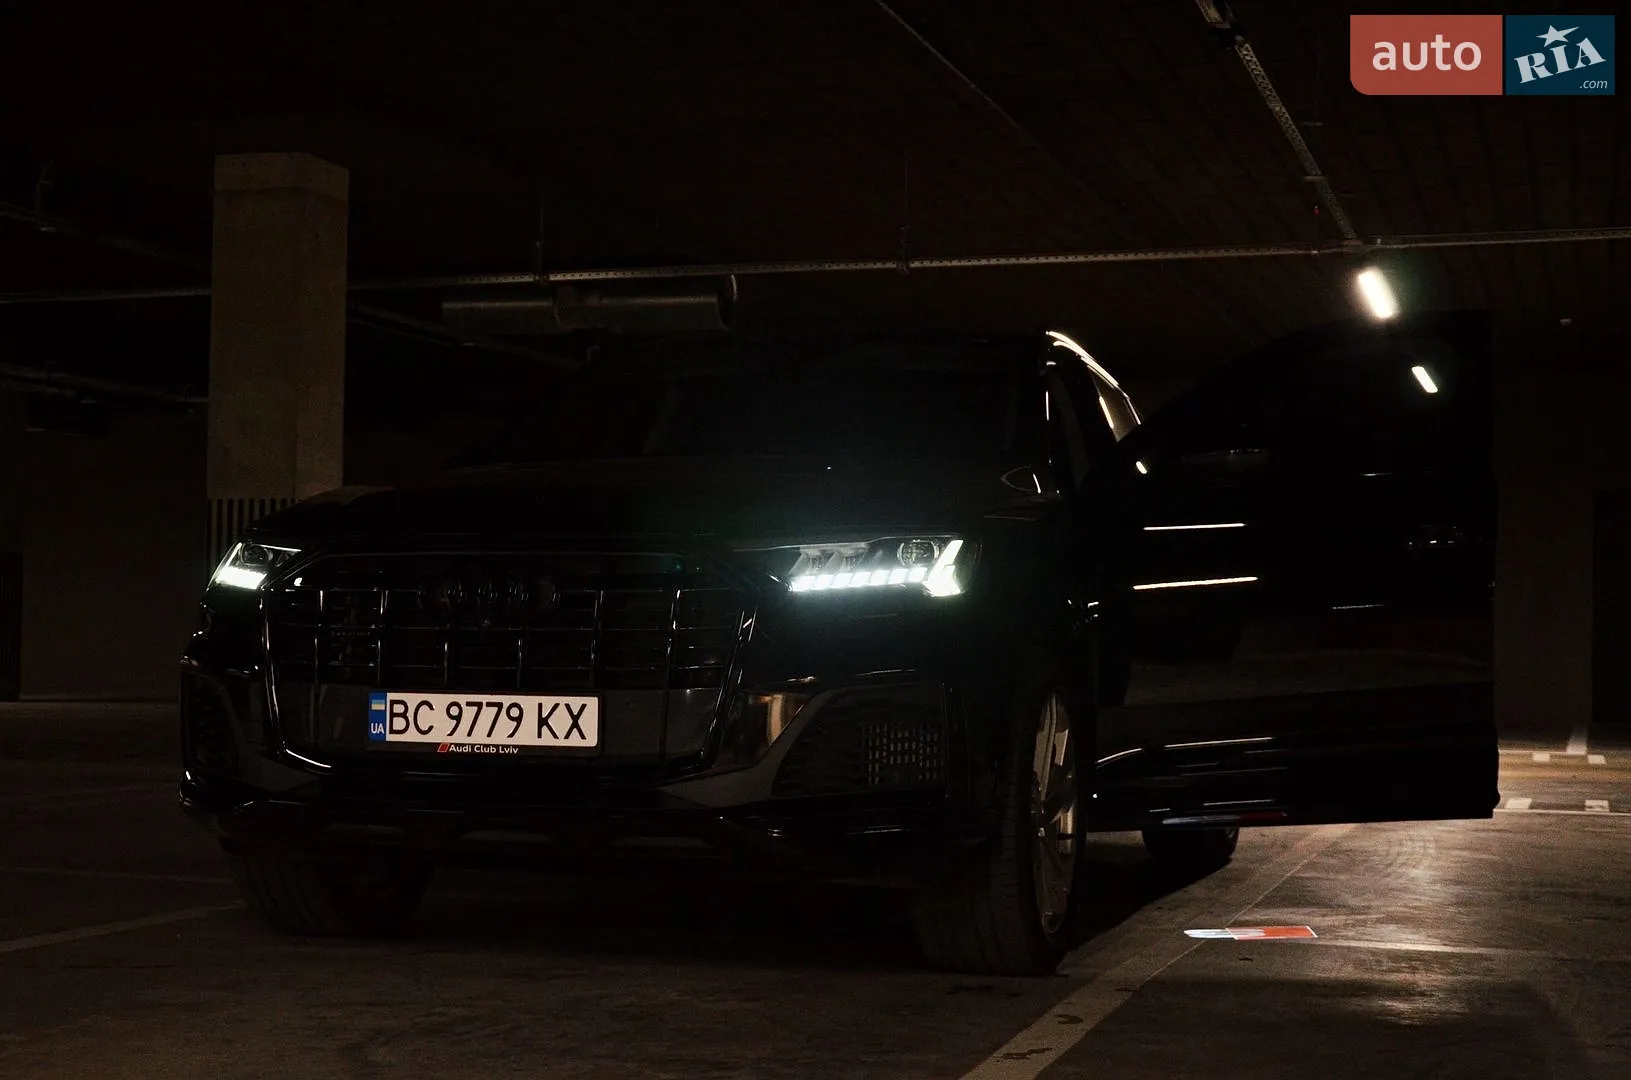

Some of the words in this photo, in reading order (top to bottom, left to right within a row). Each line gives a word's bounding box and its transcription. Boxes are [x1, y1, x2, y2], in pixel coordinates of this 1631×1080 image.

[388, 699, 435, 736] BC
[445, 700, 524, 739] 9779
[537, 702, 587, 740] KX
[370, 722, 385, 735] UA
[448, 744, 472, 753] Audi
[474, 744, 496, 754] Club
[498, 745, 519, 754] Lviv
